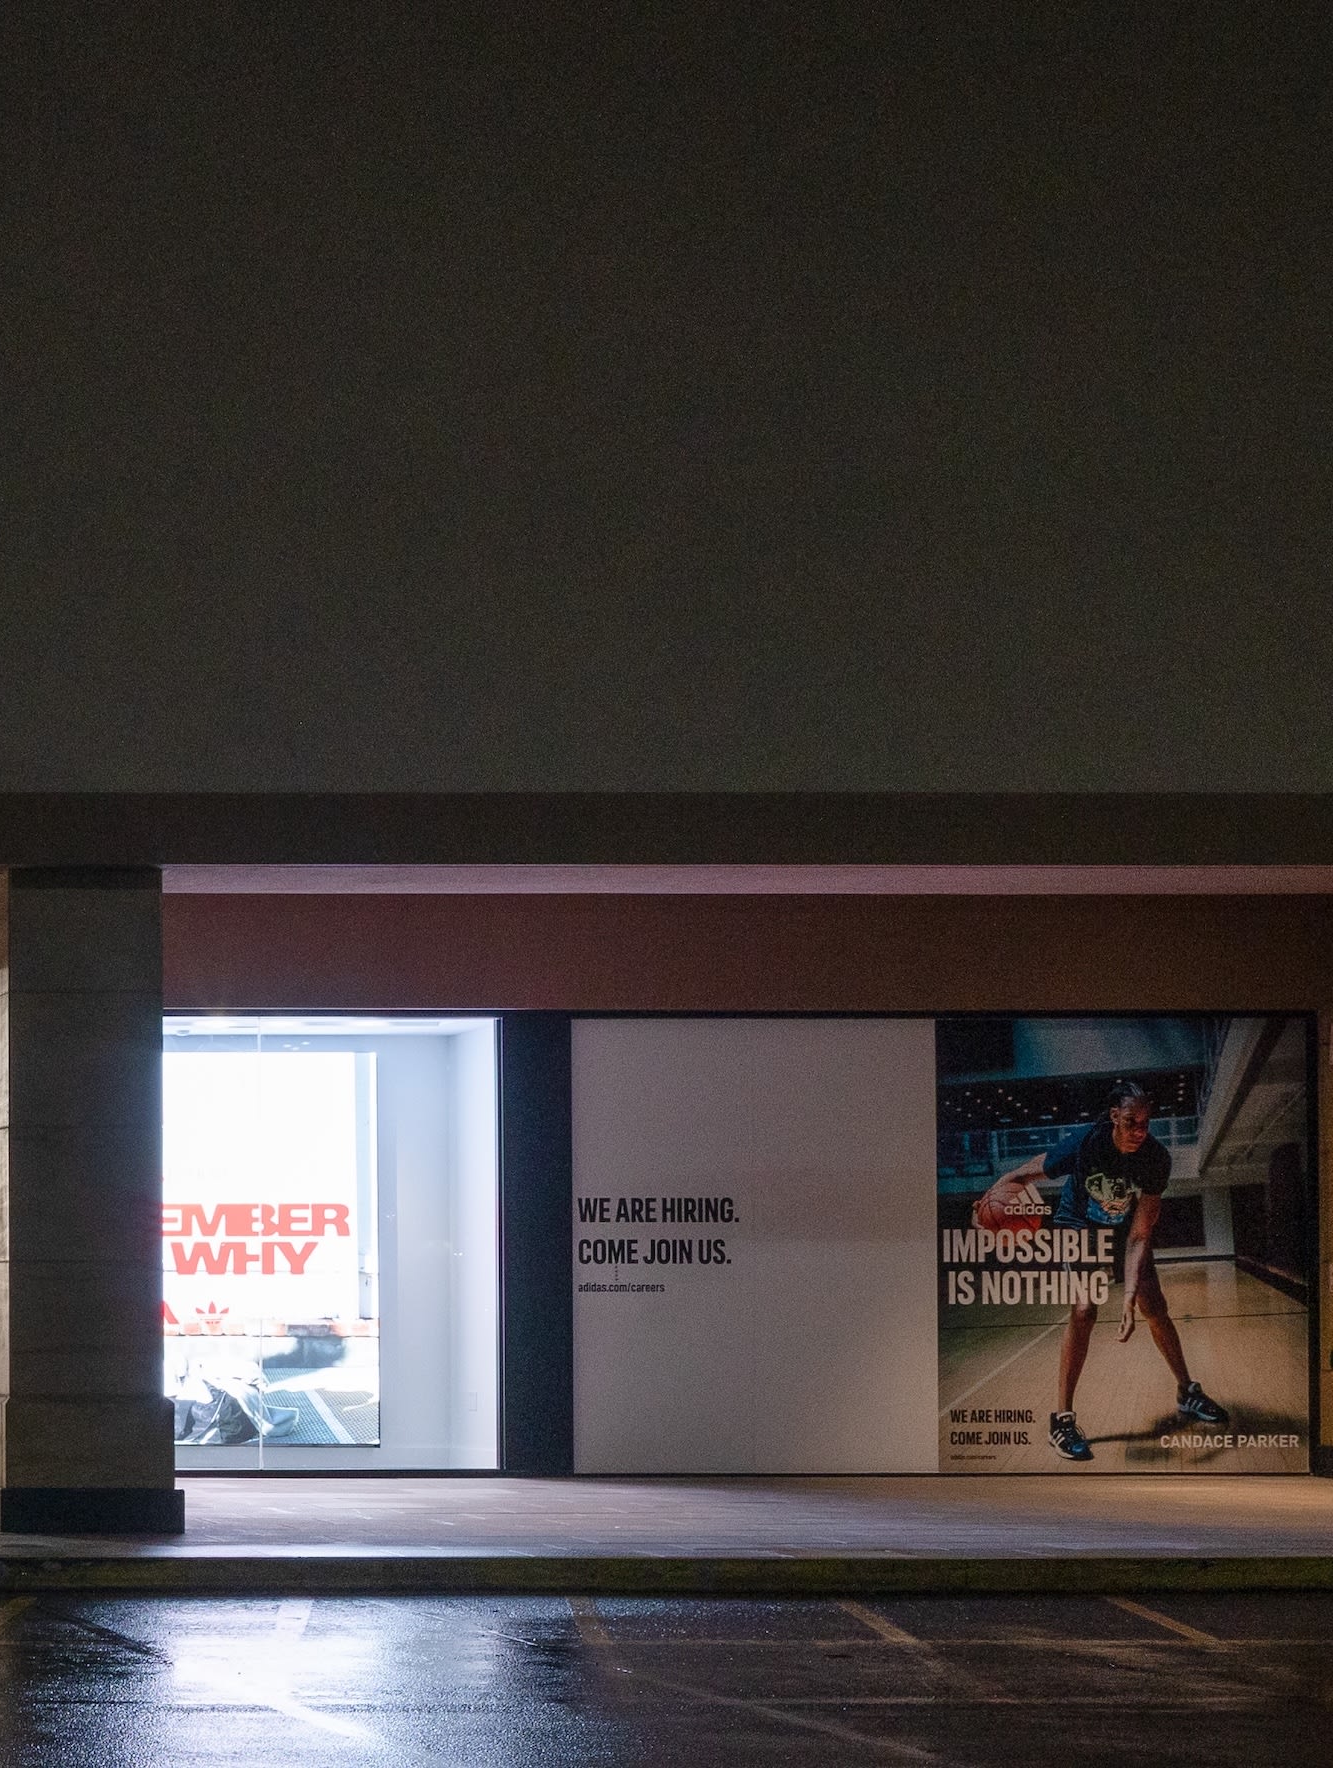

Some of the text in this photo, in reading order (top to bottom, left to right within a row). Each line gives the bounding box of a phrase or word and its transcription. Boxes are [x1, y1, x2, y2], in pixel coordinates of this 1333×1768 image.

[159, 1203, 350, 1237] EMBER
[578, 1197, 740, 1223] WE ARE HIRING.
[1004, 1203, 1053, 1216] adidas
[170, 1242, 319, 1275] WHY
[578, 1239, 732, 1265] COME JOIN US.
[942, 1228, 1115, 1264] IMPOSSIBLE
[578, 1282, 665, 1293] adidas.com/careers
[948, 1270, 1109, 1305] IS NOTHING
[950, 1409, 1036, 1424] WE ARE HIRING.
[950, 1431, 1032, 1446] COME JOIN US.
[1160, 1434, 1300, 1449] CANDACE PARKER
